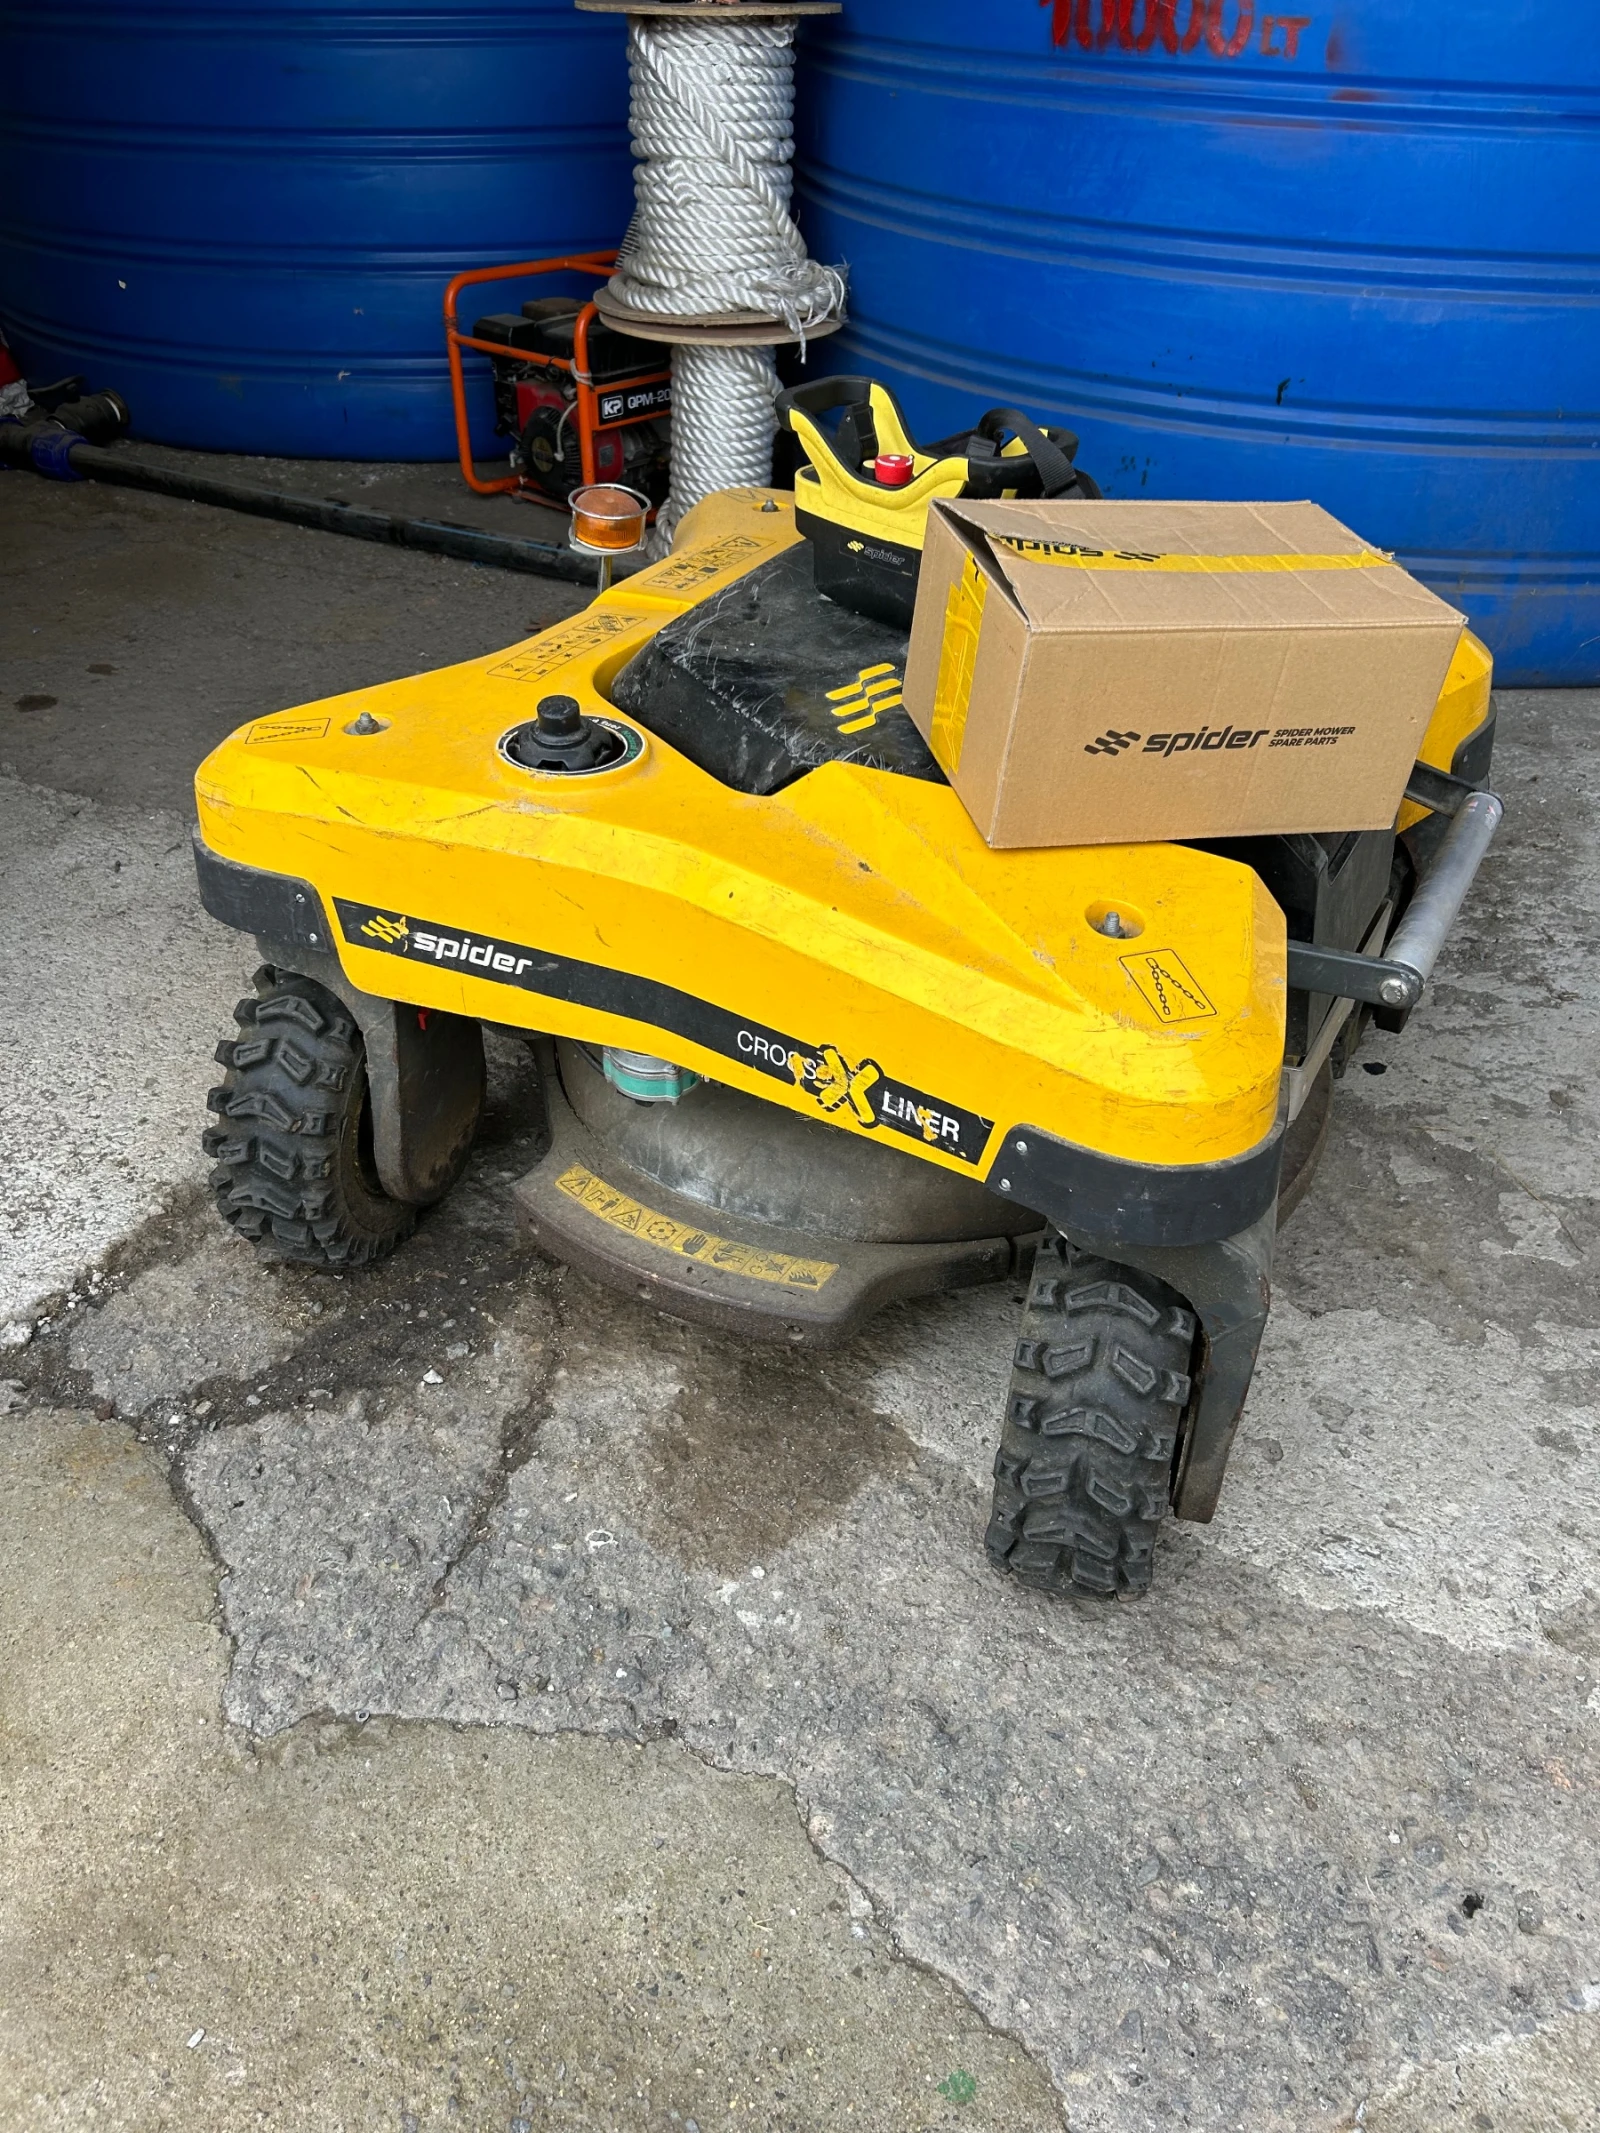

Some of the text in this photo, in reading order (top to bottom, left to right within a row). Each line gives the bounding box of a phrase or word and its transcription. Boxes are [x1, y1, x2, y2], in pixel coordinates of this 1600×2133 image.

[1258, 15, 1311, 59] LT
[603, 399, 622, 415] KP
[863, 546, 906, 566] spider
[1141, 725, 1270, 758] spider
[1268, 736, 1339, 747] SPARE PARTS
[1273, 726, 1356, 738] SPIDER MOWER
[413, 931, 533, 975] spider
[881, 1090, 960, 1143] LINER
